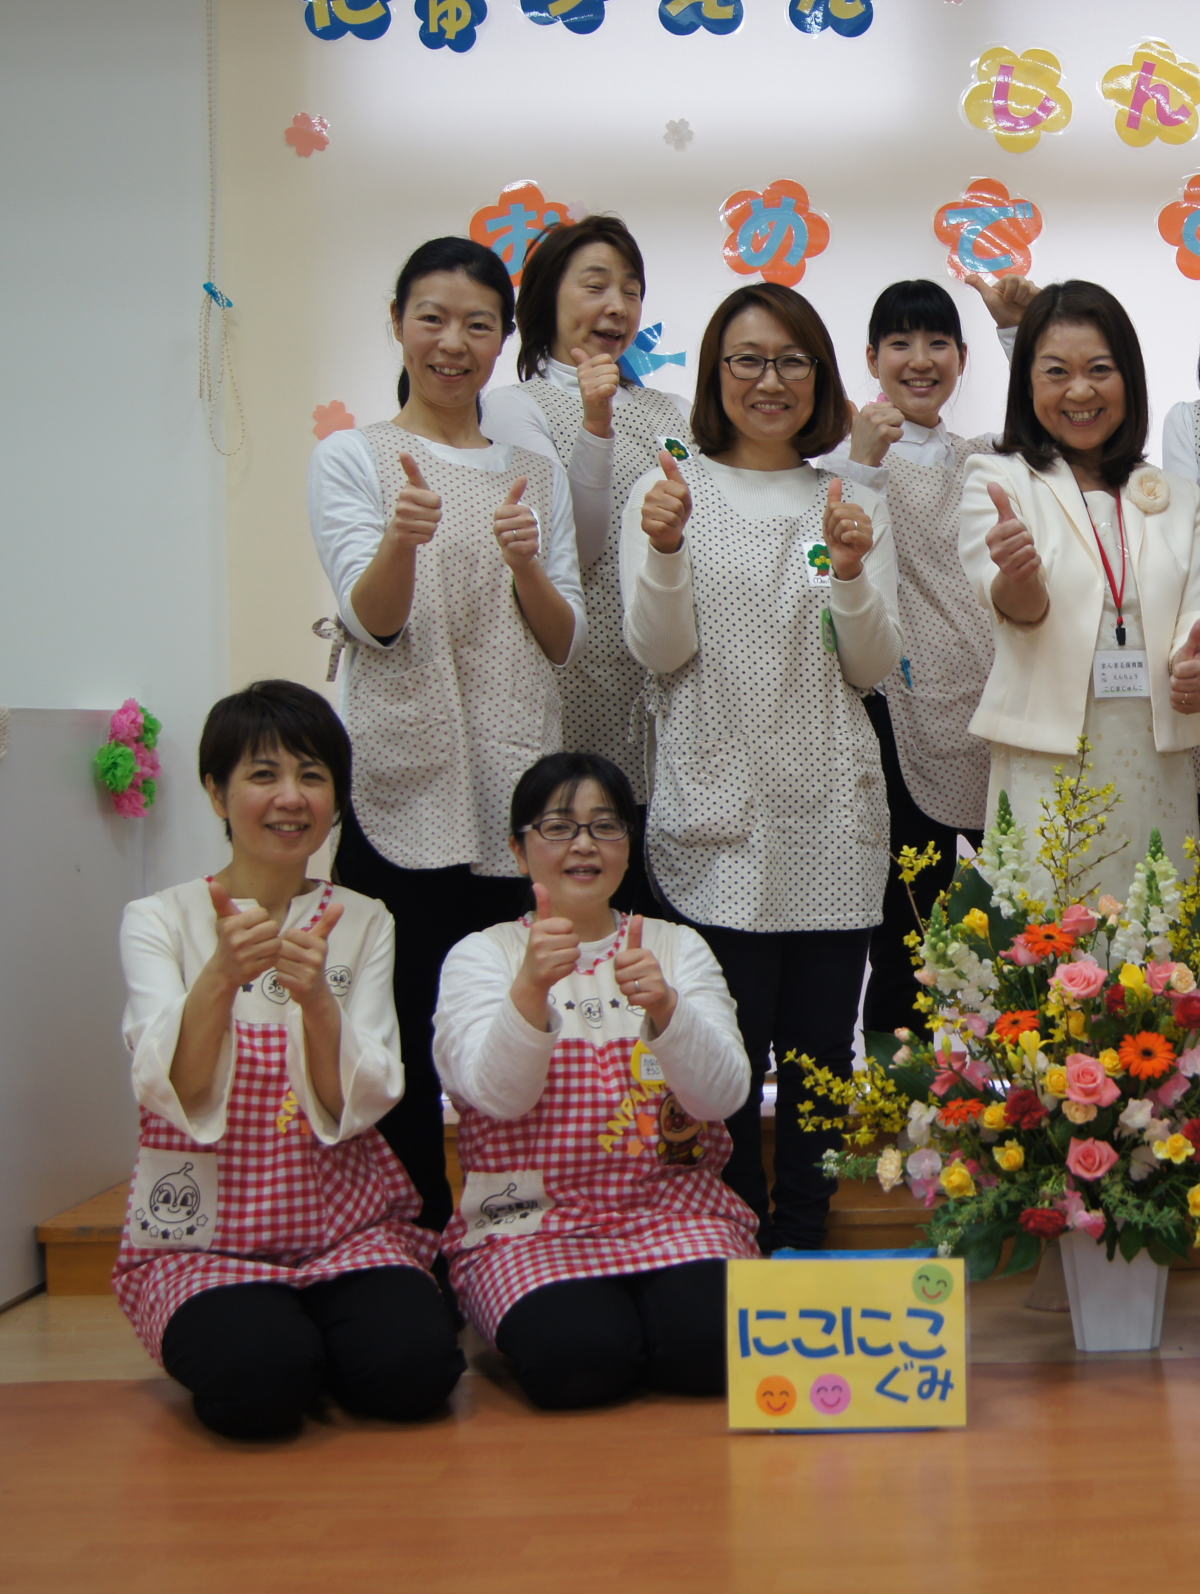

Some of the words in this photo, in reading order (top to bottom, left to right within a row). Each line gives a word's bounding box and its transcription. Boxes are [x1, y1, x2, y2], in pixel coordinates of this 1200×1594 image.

[738, 1306, 947, 1359] にこにこ
[875, 1360, 955, 1404] ぐみ
